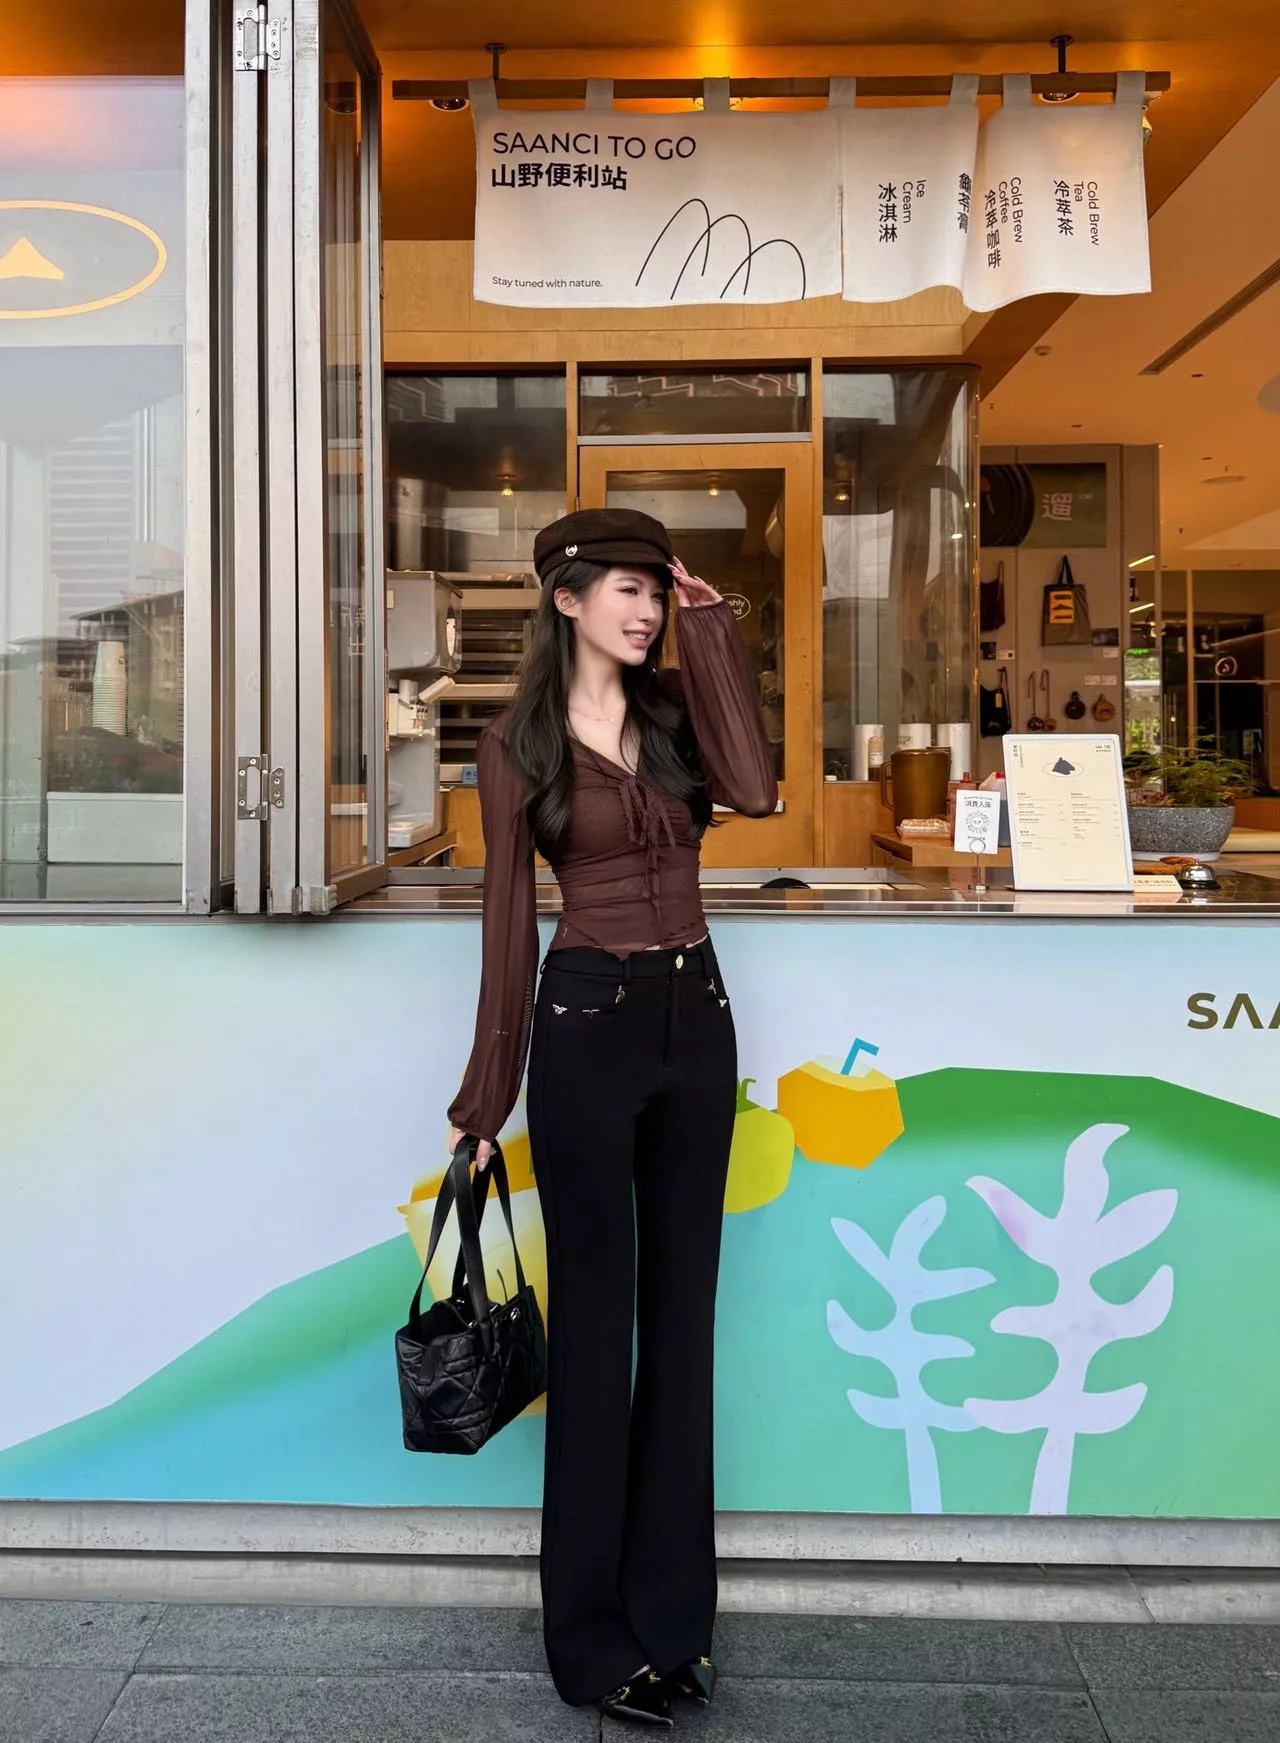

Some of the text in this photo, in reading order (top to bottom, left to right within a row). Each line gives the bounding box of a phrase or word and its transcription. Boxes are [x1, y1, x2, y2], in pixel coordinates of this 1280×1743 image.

[493, 132, 697, 160] SAANCI TO GO
[491, 162, 628, 191] 山野便利站
[916, 179, 927, 198] Ice
[1073, 181, 1084, 202] Tea
[878, 182, 898, 243] 冰淇淋
[902, 181, 914, 223] Cream
[998, 181, 1009, 224] Coffee
[1010, 176, 1024, 243] Cold Brew
[1053, 179, 1074, 236] 冷萃茶
[1087, 181, 1100, 246] Cold Brew
[984, 189, 1002, 269] 冷萃咖啡
[492, 276, 603, 288] Stay tuned with nature.
